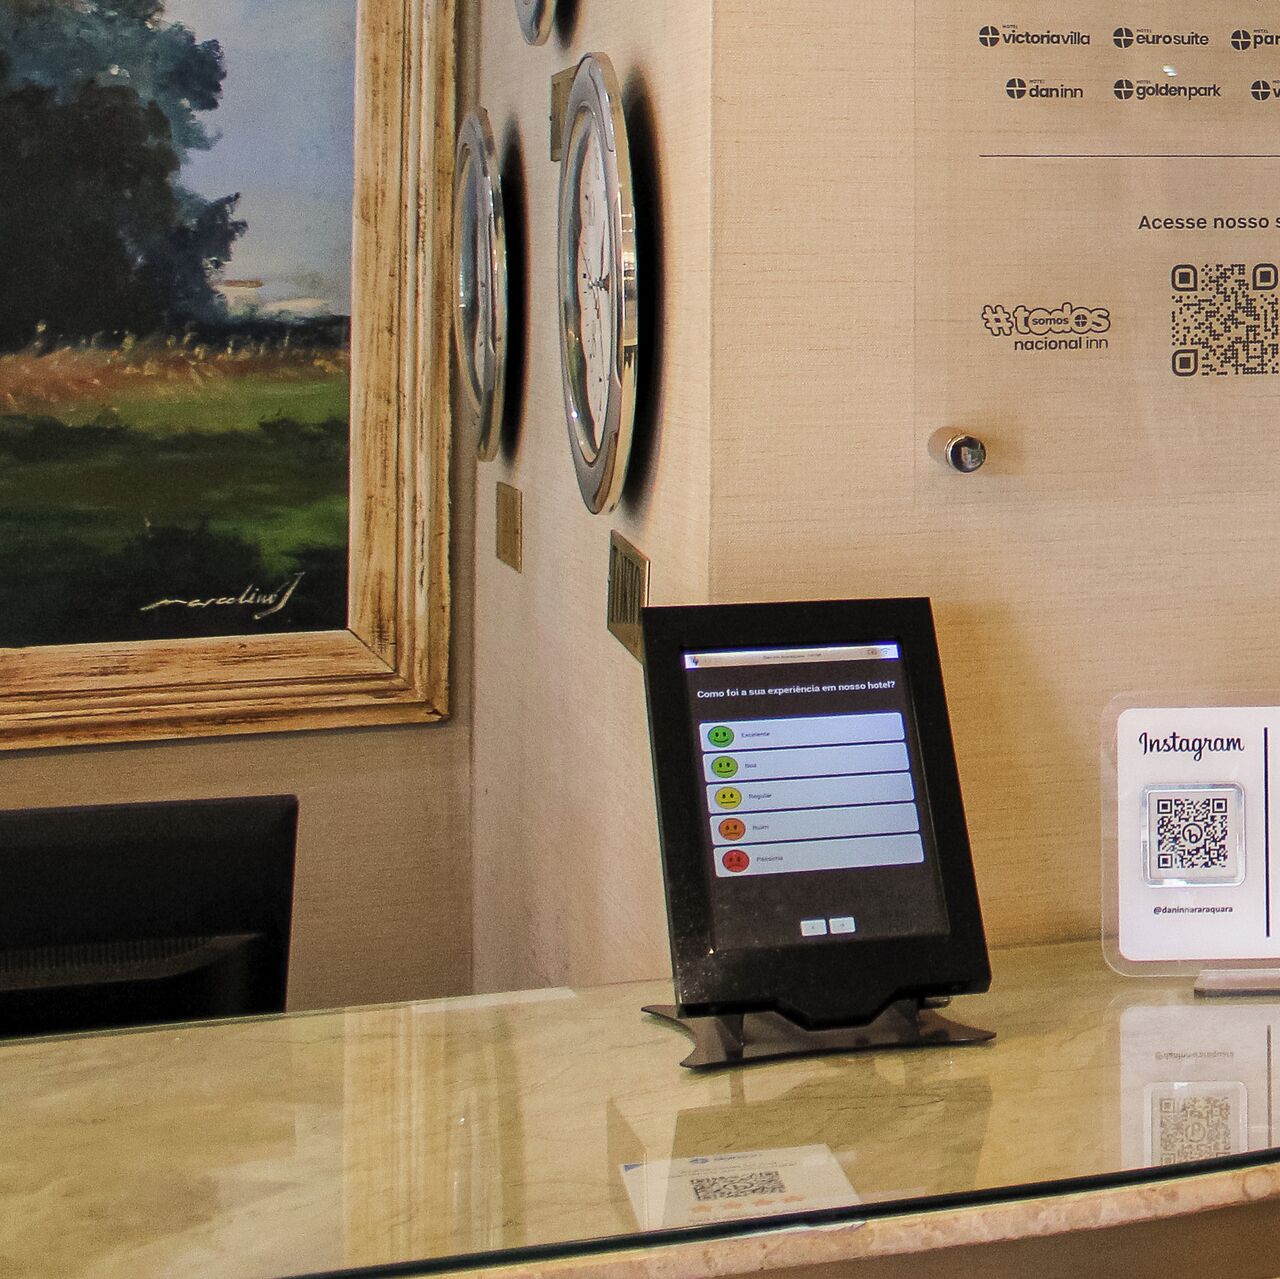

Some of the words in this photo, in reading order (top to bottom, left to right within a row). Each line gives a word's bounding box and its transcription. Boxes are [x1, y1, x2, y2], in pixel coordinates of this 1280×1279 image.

[1138, 215, 1208, 230] Acesse
[1213, 216, 1269, 229] nosso
[1032, 317, 1069, 326] somos
[697, 689, 725, 699] Como
[726, 688, 739, 697] foi
[748, 688, 766, 696] sua
[767, 685, 821, 696] experiência
[838, 683, 866, 691] nosso
[867, 680, 895, 689] hotel?
[1139, 732, 1245, 762] Instagram
